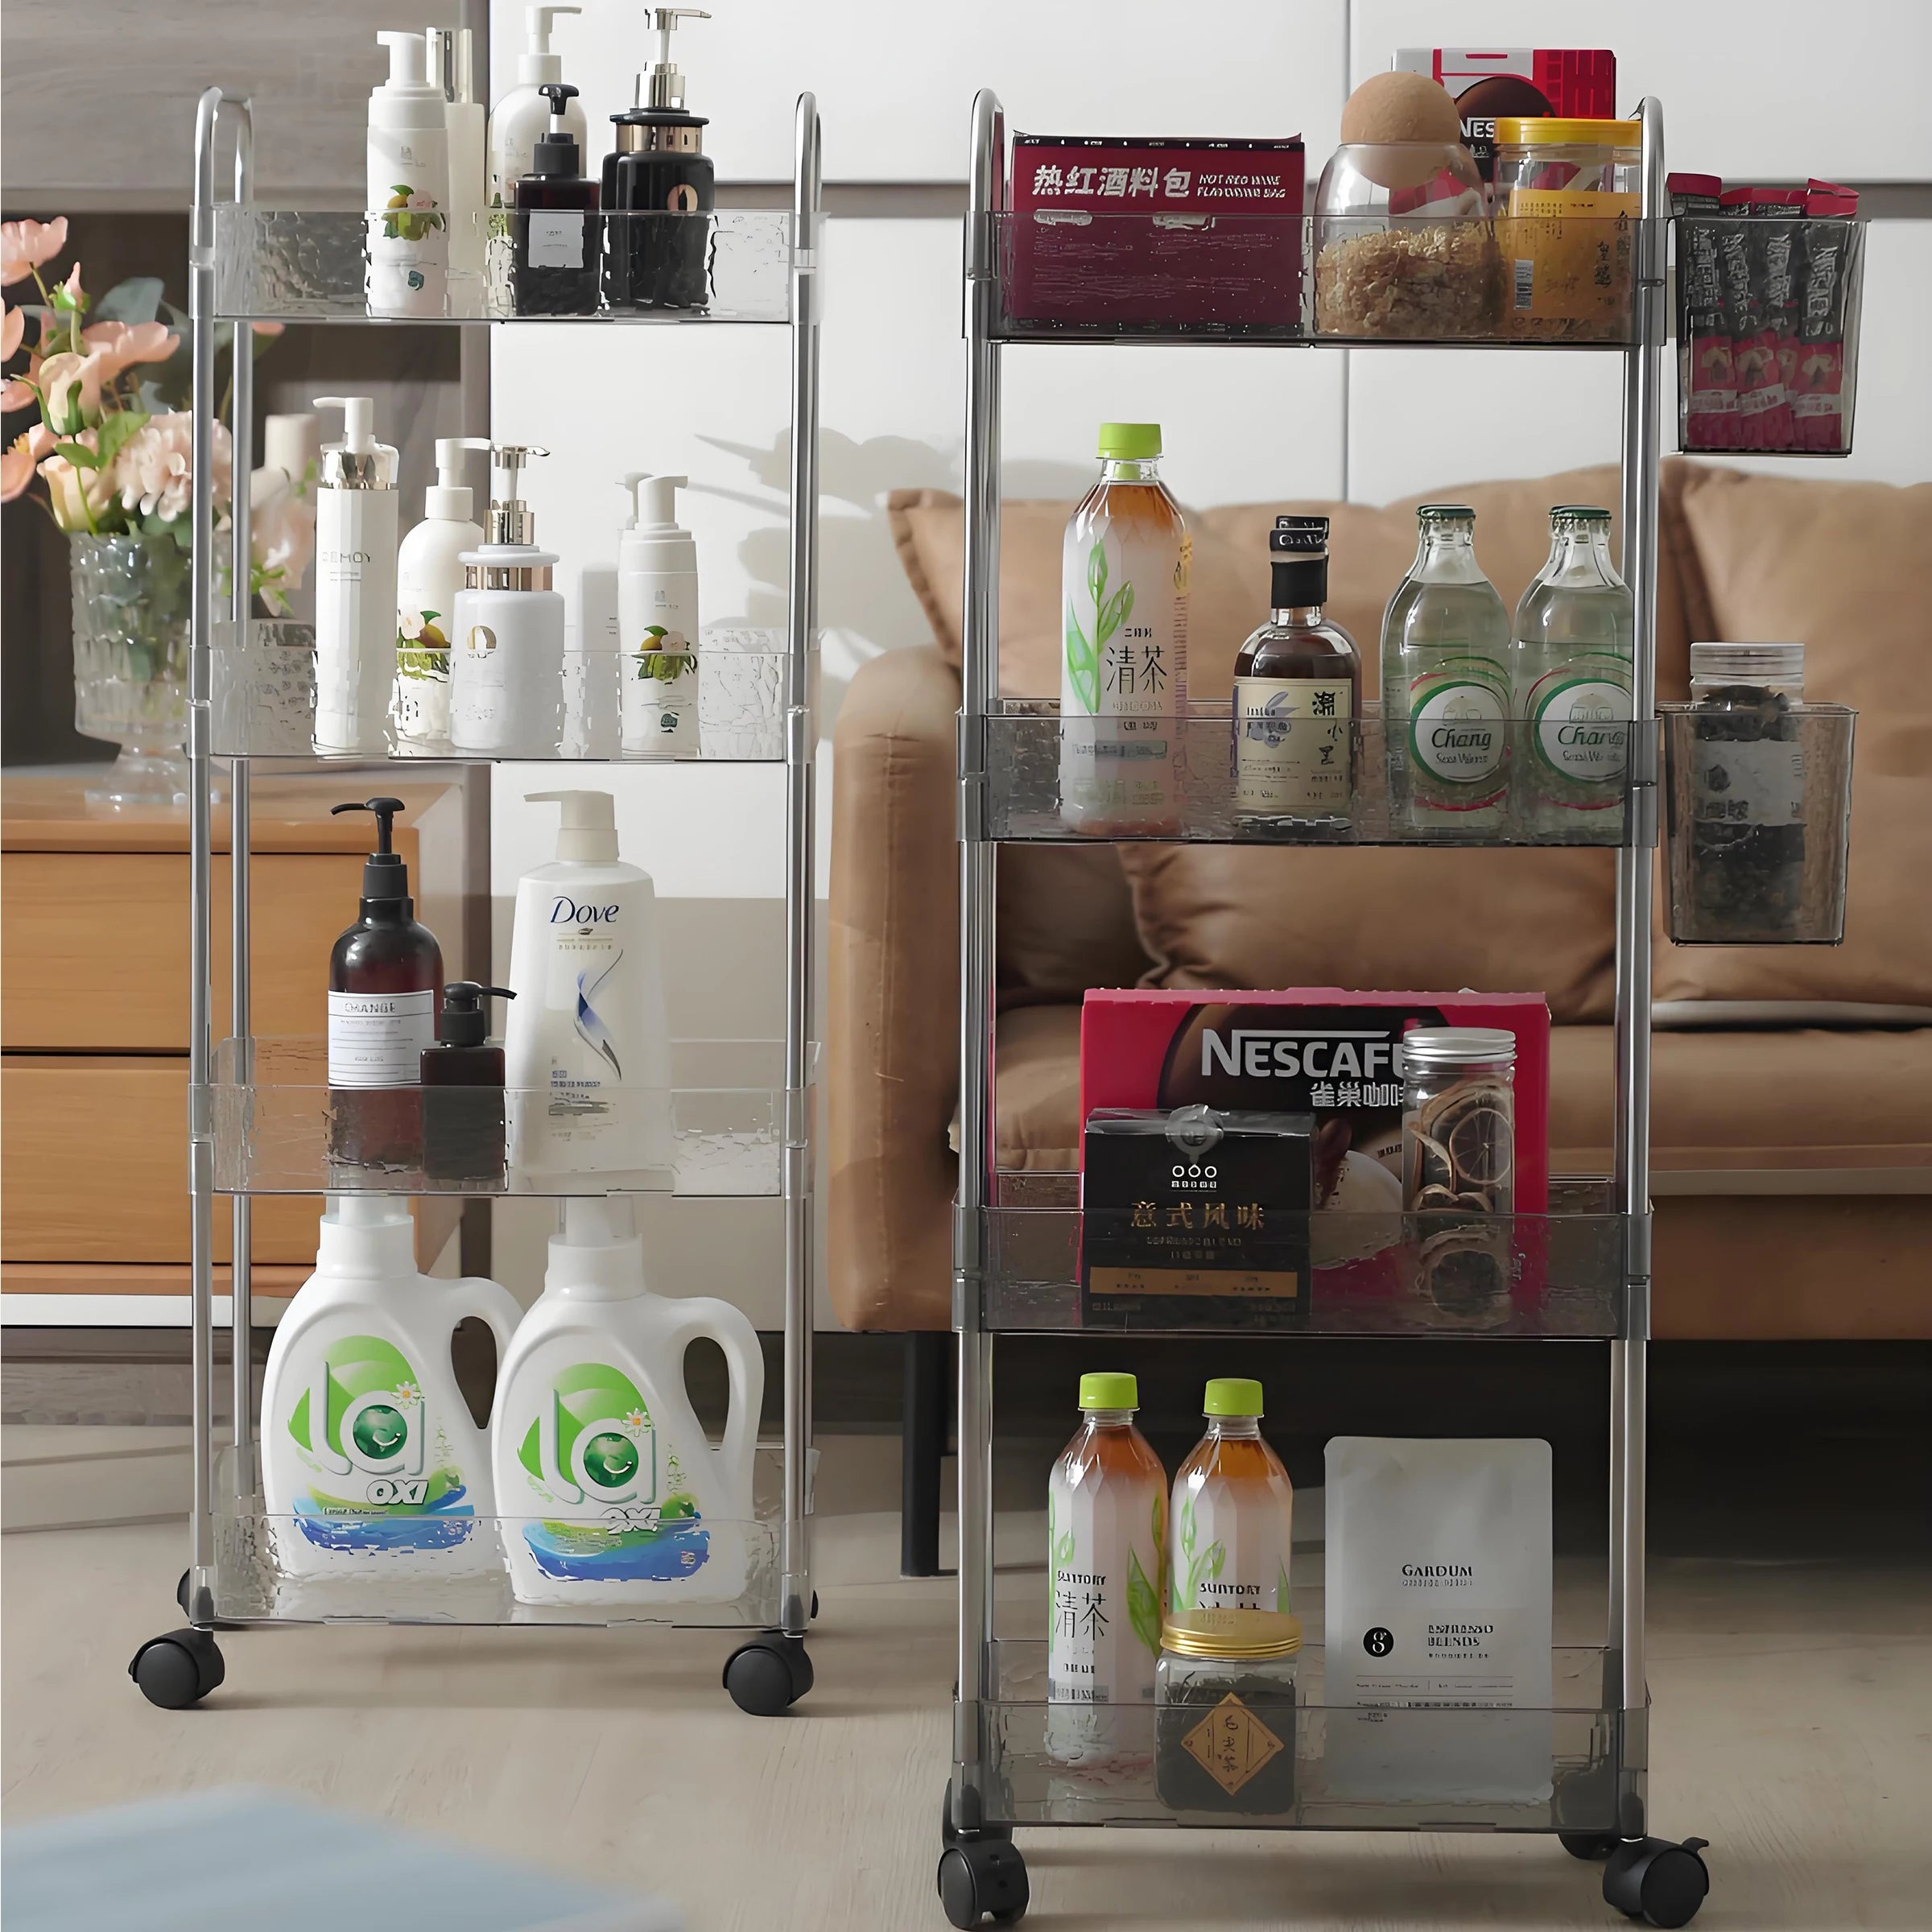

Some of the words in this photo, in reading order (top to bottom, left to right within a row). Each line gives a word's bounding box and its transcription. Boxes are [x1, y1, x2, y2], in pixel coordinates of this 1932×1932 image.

[1032, 164, 1191, 198] 热红酒料包
[1106, 646, 1167, 694] 清茶
[1431, 728, 1492, 751] Chang
[550, 896, 620, 924] Dove
[1130, 1201, 1265, 1230] 意式风味
[366, 1479, 429, 1505] OXI
[1199, 1583, 1261, 1595] SUNTORY
[1055, 1591, 1109, 1641] 清茶
